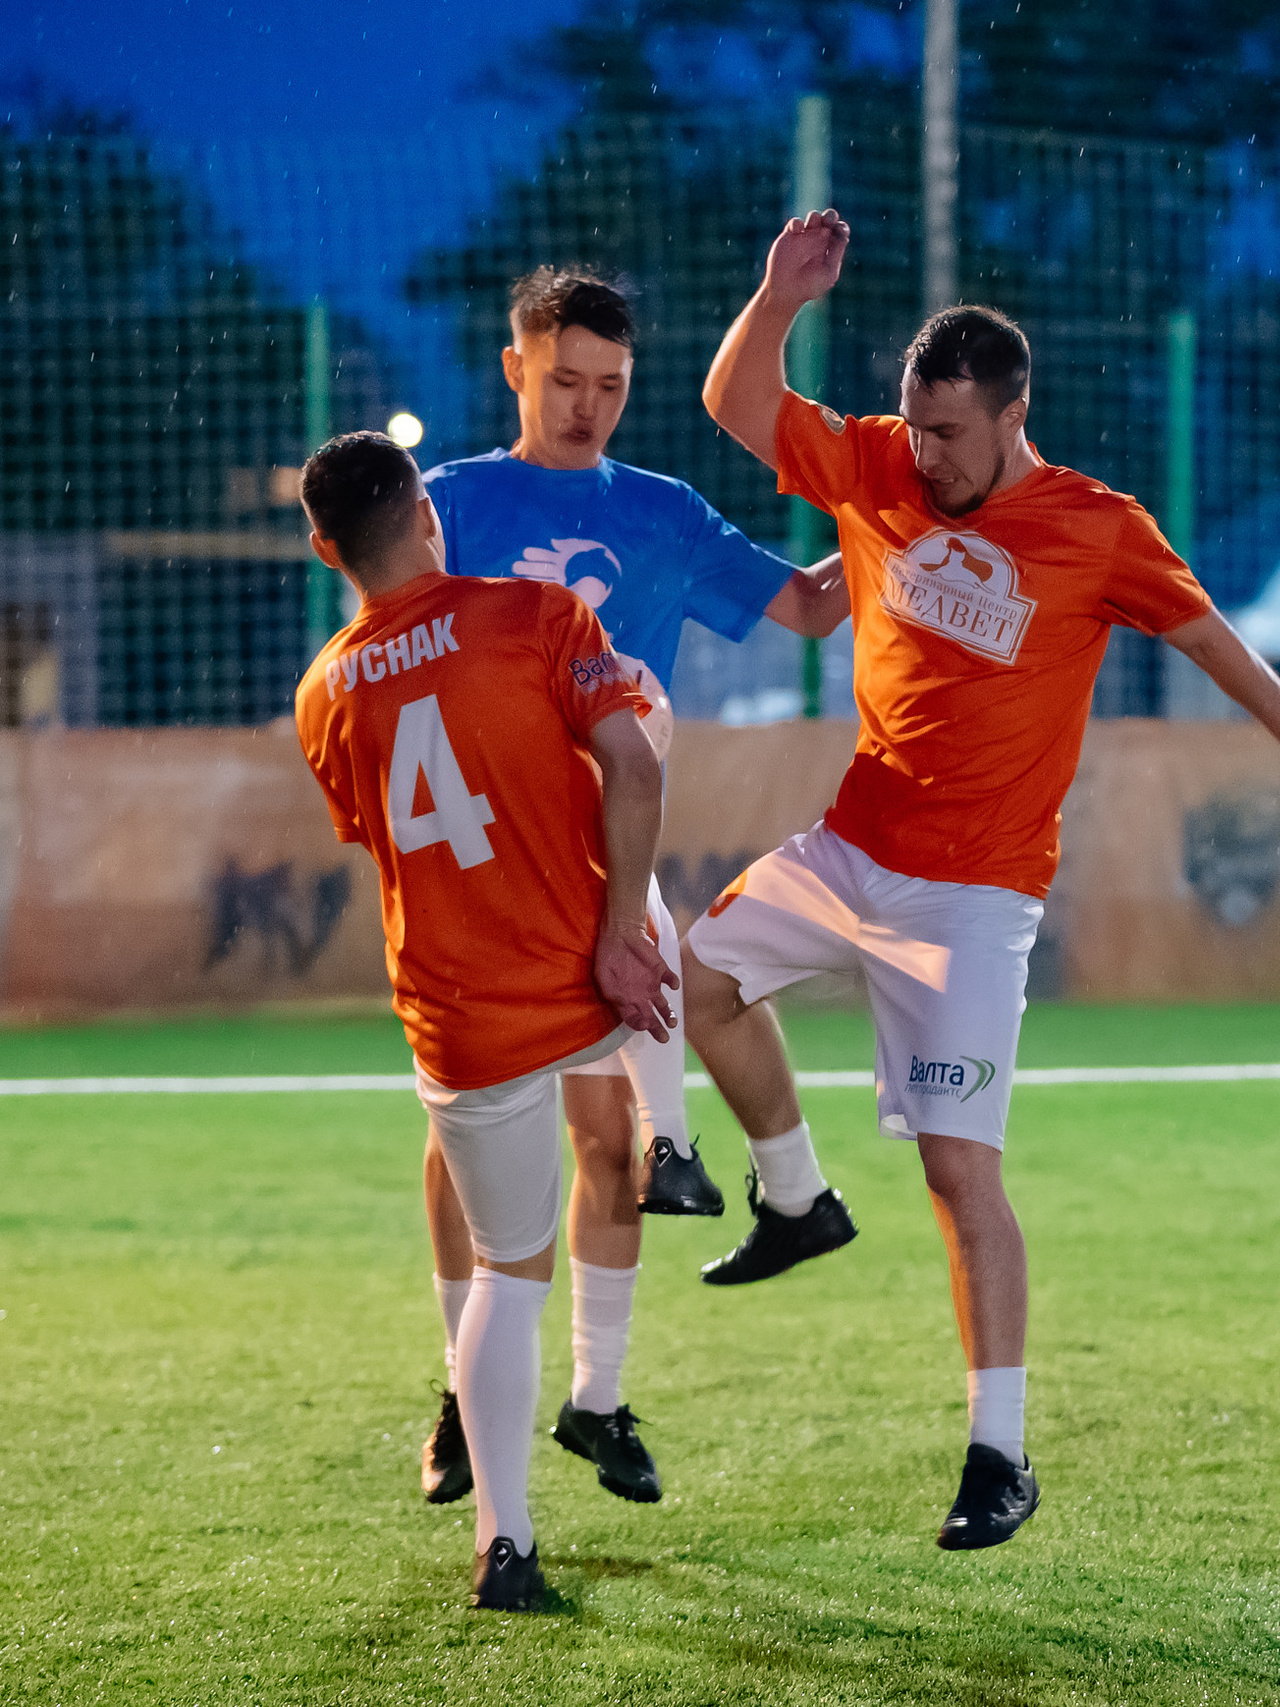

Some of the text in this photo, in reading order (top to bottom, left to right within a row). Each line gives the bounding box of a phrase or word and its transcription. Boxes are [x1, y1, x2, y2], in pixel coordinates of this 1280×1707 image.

[325, 612, 460, 702] РУСНАК
[387, 693, 497, 870] 4
[909, 1055, 965, 1086] Валта
